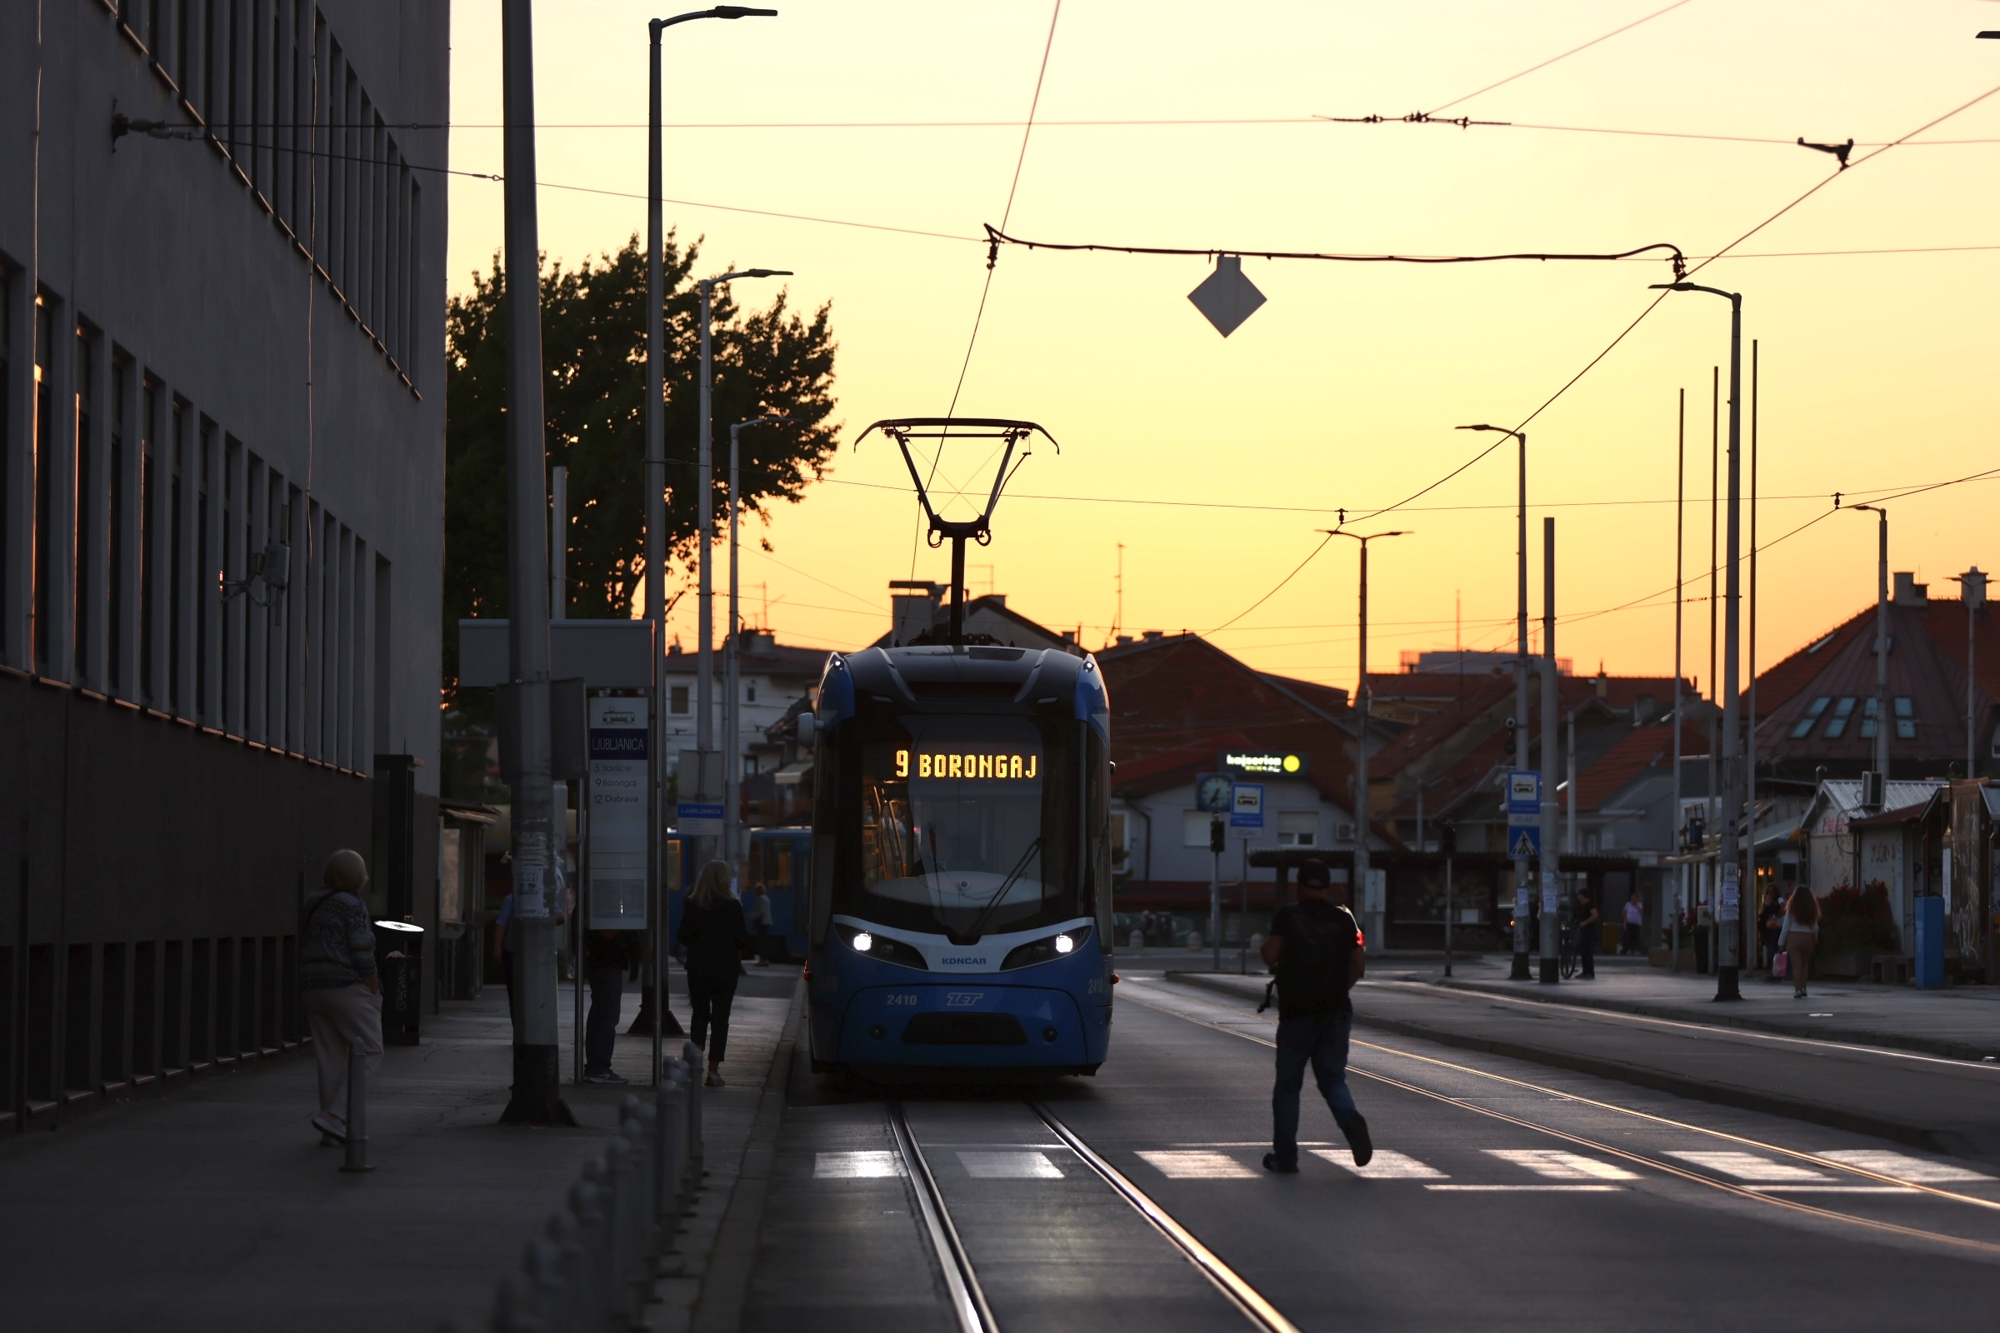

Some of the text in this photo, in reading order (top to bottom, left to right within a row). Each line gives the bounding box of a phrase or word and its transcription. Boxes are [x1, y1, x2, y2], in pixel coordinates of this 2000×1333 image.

[592, 738, 645, 751] LJUBLJANICA
[593, 763, 600, 773] 3
[896, 750, 1036, 778] 9 BORONGAJ
[595, 778, 637, 788] 9 Borongaj
[593, 794, 639, 804] 12 Dubrava
[886, 994, 917, 1005] 2410
[946, 992, 984, 1006] ZET
